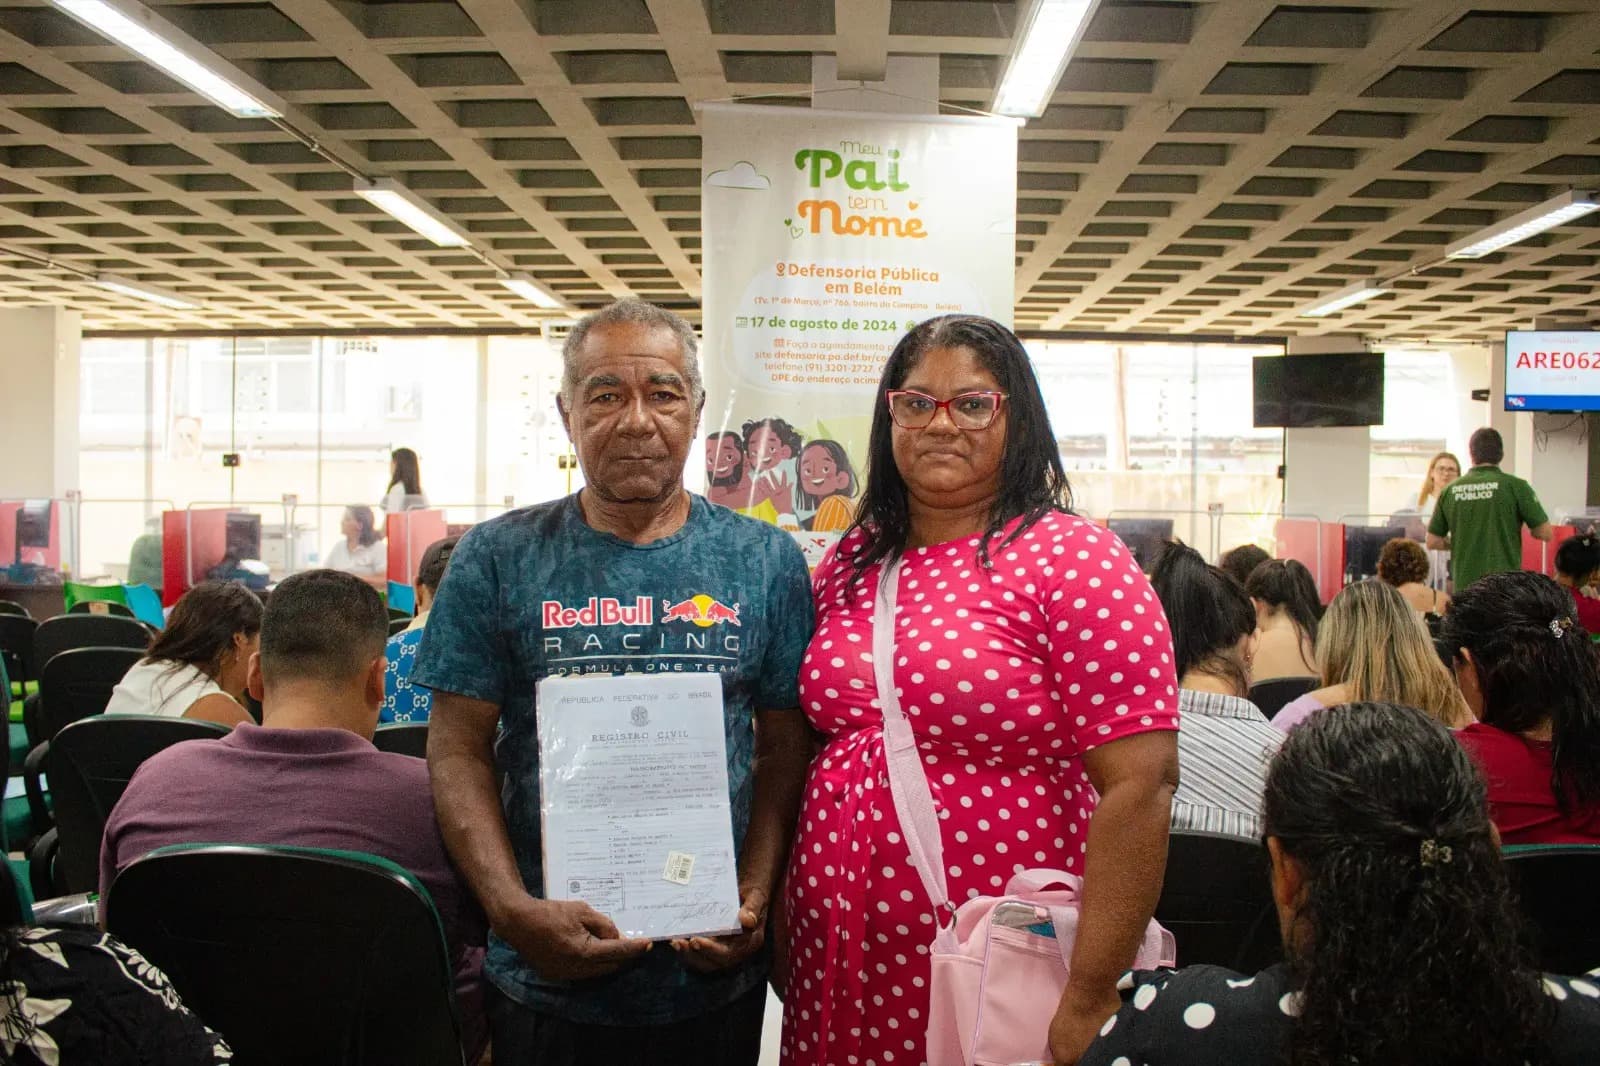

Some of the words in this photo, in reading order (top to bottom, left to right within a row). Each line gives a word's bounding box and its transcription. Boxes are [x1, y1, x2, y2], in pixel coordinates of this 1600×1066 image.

[840, 140, 882, 155] Meu
[795, 149, 910, 192] Pai
[848, 195, 888, 210] tem
[798, 200, 928, 238] Nome
[788, 263, 876, 280] Defensoria
[881, 266, 939, 282] Pública
[825, 283, 849, 294] em
[854, 281, 902, 296] Belém
[751, 316, 764, 328] 17
[768, 315, 786, 328] de
[789, 318, 838, 331] agosto
[841, 318, 859, 331] de
[863, 319, 897, 331] 2024
[1516, 352, 1600, 369] ARE062
[542, 597, 598, 629] Red
[600, 596, 653, 626] Bull
[545, 632, 740, 652] RACING
[547, 663, 634, 674] FORMULA
[646, 662, 683, 672] ONE
[695, 663, 738, 673] TEAM
[656, 730, 689, 739] CIVIL
